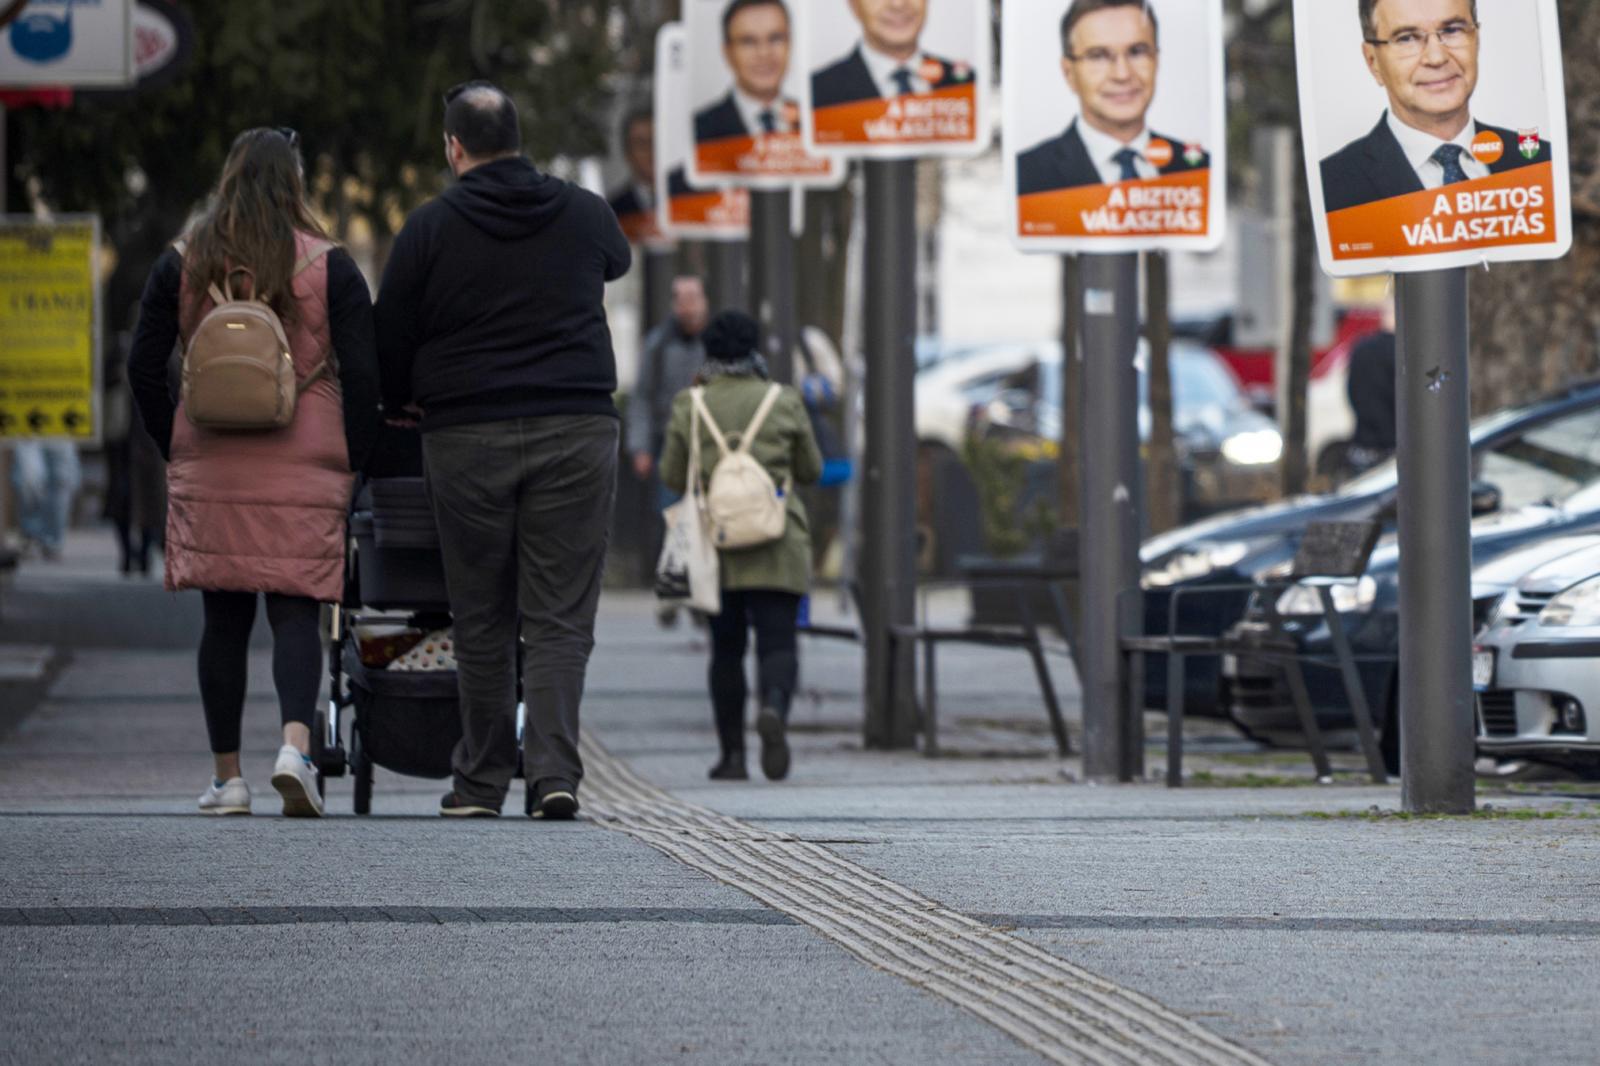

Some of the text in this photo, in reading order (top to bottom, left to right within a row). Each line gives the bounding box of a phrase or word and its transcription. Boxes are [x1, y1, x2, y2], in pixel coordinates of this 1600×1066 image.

[1109, 187, 1202, 207] A BIZTOS
[1433, 187, 1543, 216] A BIZTOS
[1081, 206, 1202, 231] VÁLASZTÁS
[1402, 212, 1545, 245] VÁLASZTÁS
